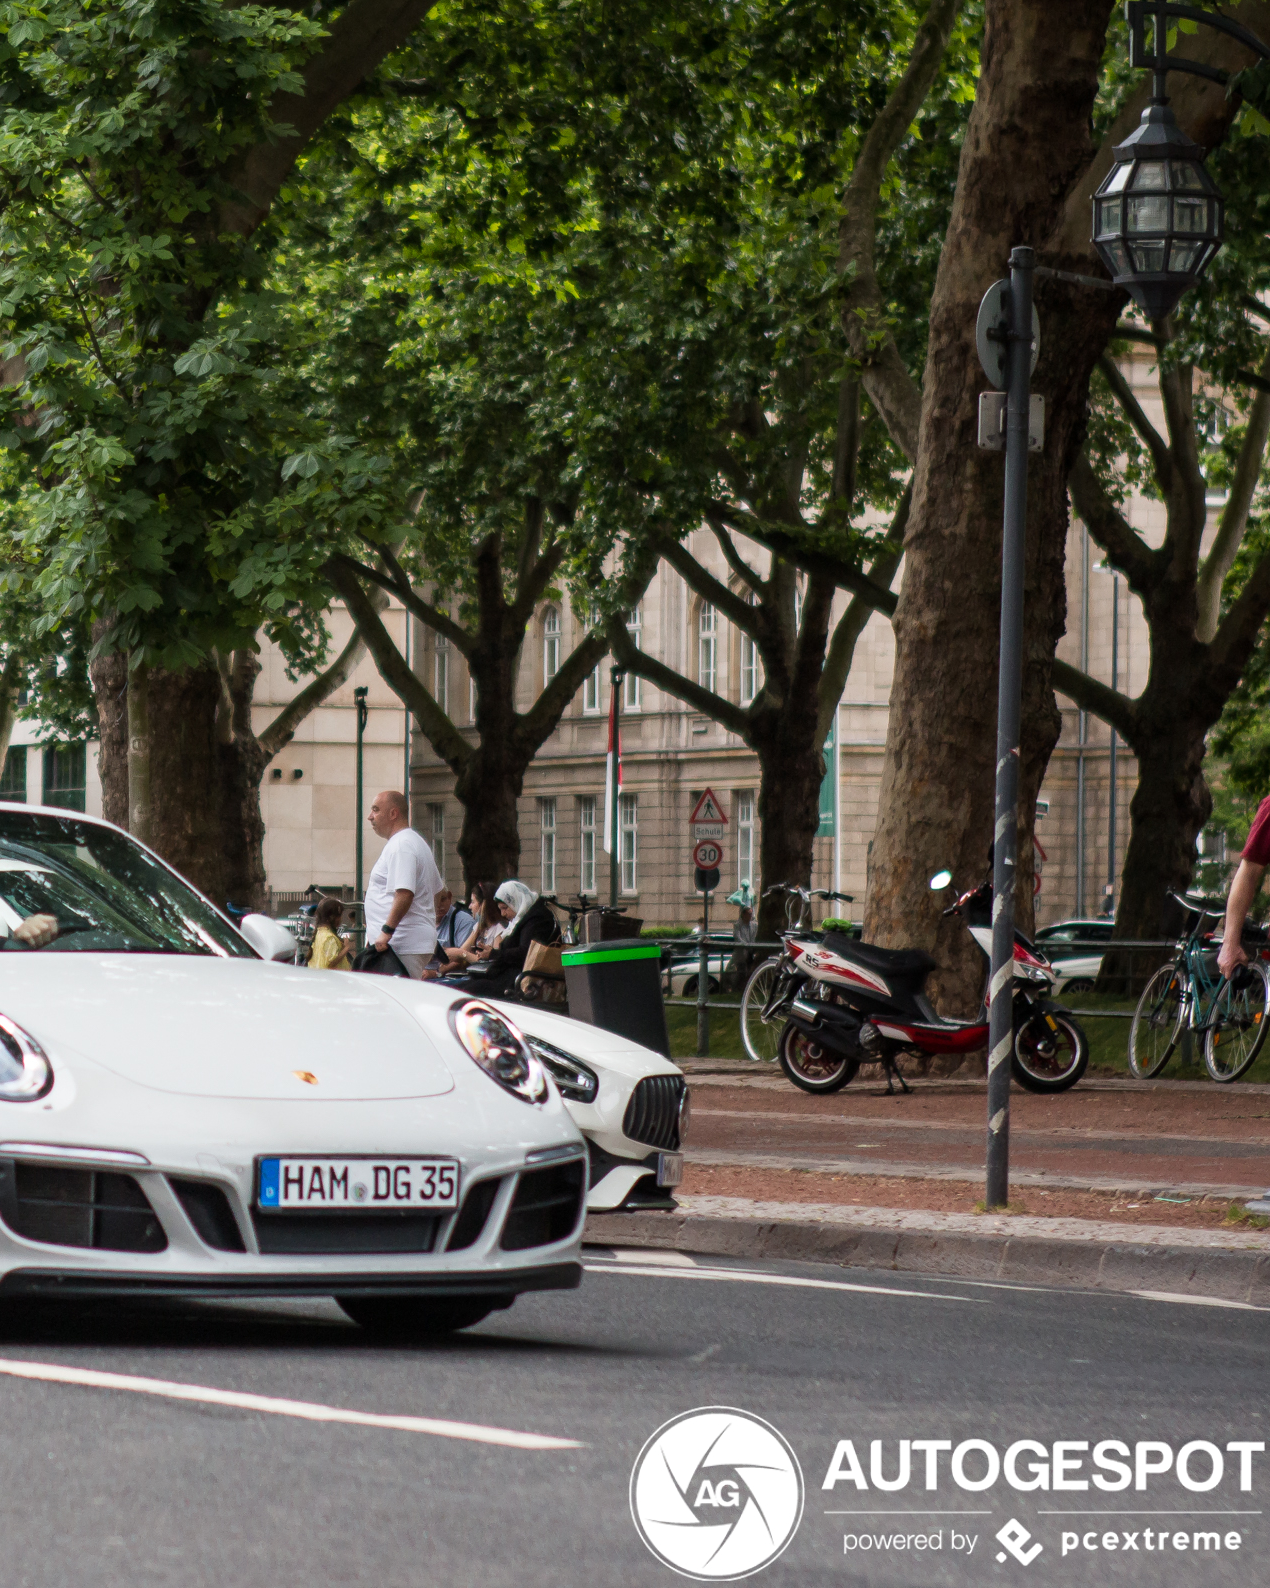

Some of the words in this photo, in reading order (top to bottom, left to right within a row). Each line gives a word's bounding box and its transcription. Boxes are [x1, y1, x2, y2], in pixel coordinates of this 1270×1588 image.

[695, 827, 721, 836] Schule
[699, 848, 717, 862] 30
[283, 1165, 349, 1200] HAM
[372, 1165, 411, 1200] DG
[420, 1165, 456, 1200] 35
